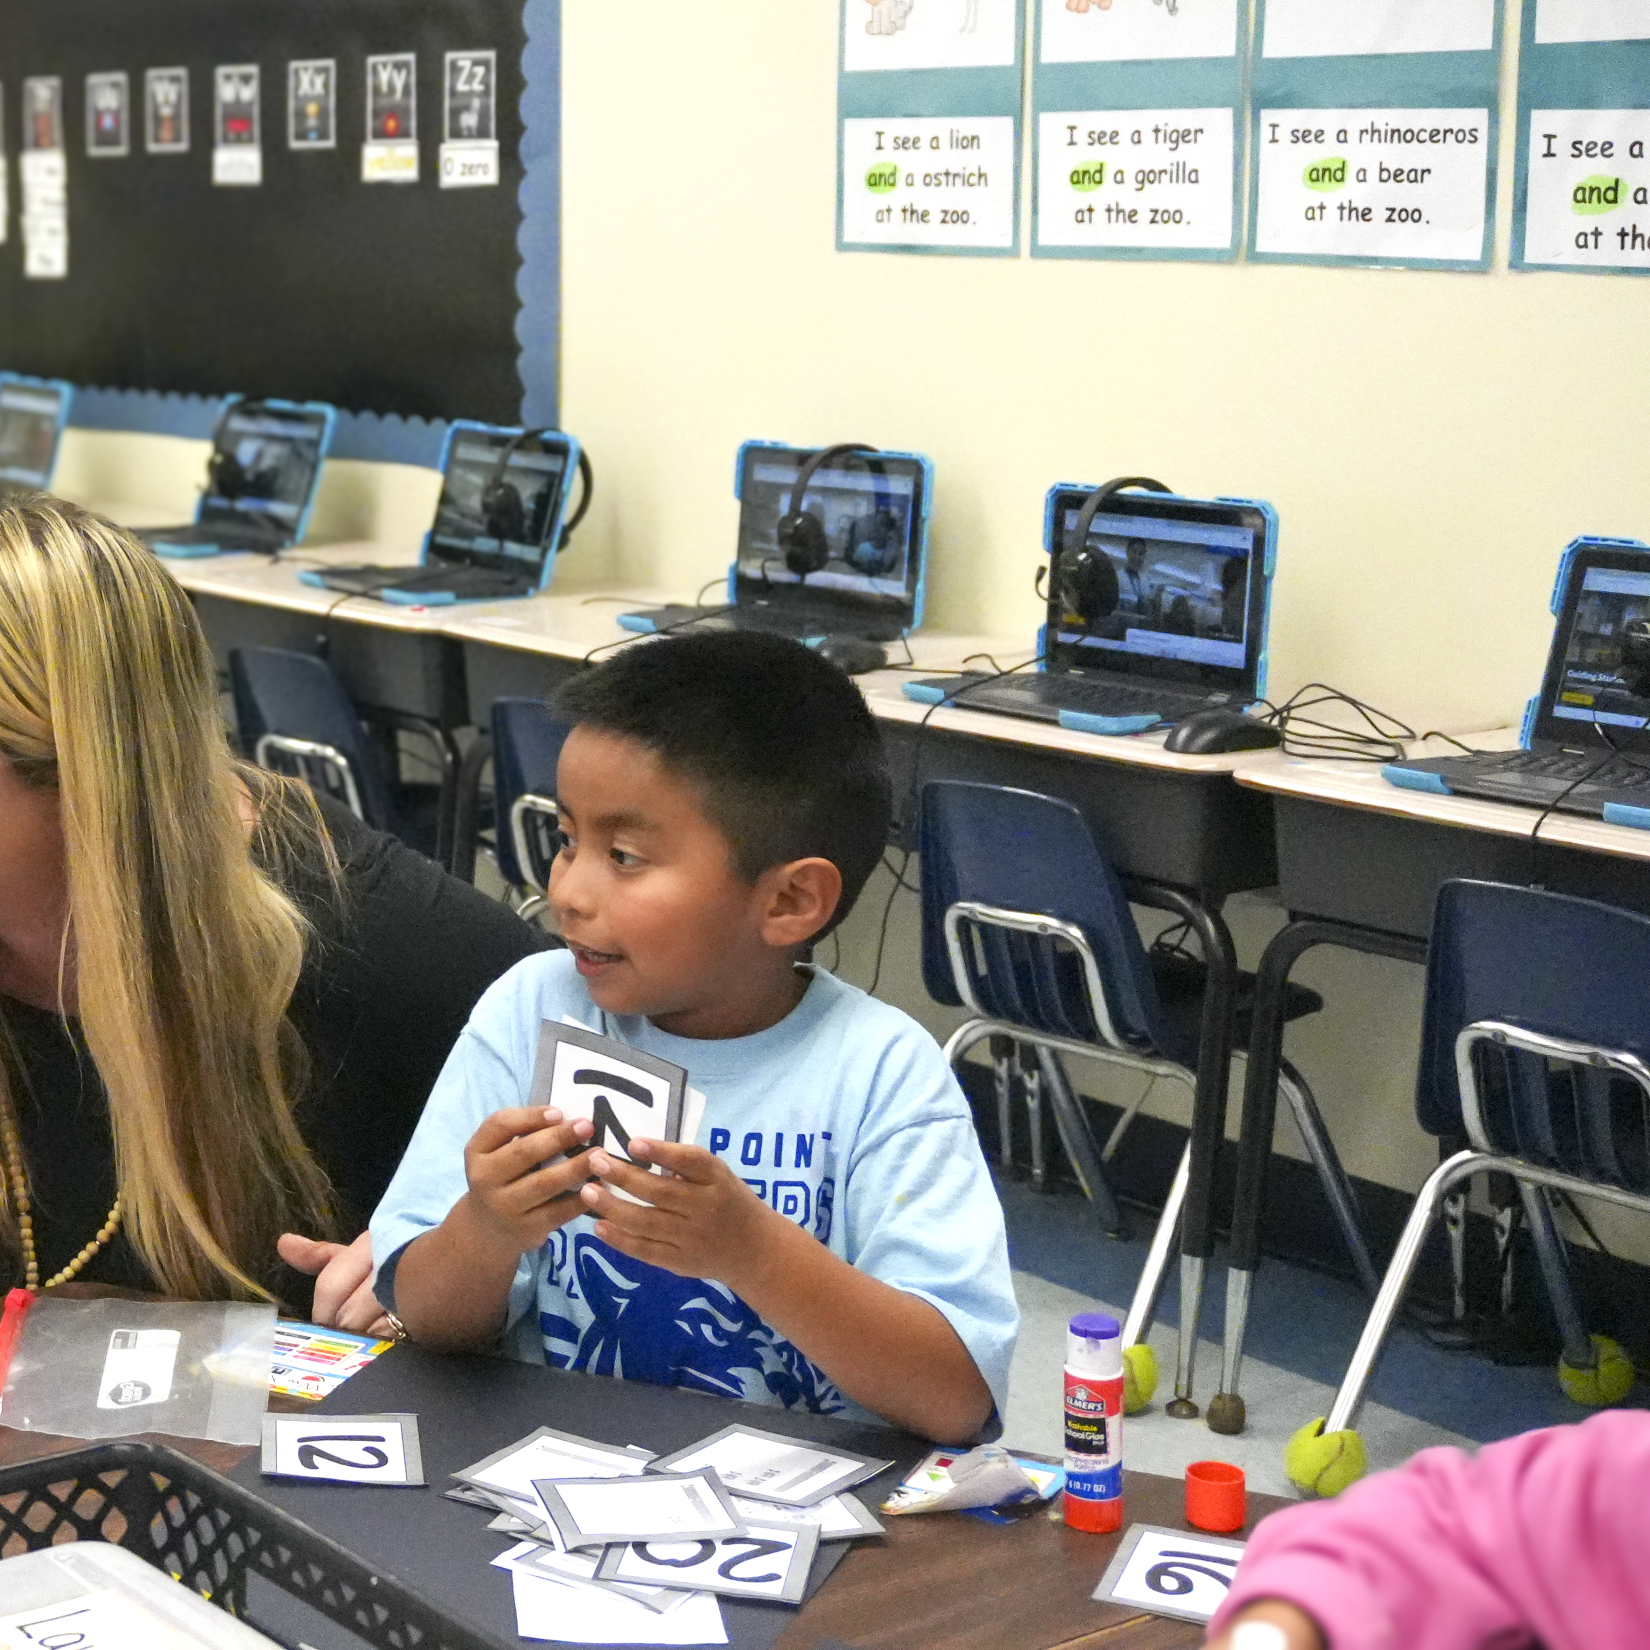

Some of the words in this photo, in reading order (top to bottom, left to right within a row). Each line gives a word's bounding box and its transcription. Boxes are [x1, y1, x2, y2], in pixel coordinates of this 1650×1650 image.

[298, 67, 326, 96] Xx
[377, 65, 407, 99] Yy
[455, 60, 486, 91] Zz
[875, 131, 885, 151] I
[893, 135, 921, 151] see
[929, 135, 941, 150] a
[949, 128, 981, 150] lion
[1066, 125, 1078, 147] I
[1087, 130, 1120, 147] see
[1130, 129, 1142, 145] a
[1151, 124, 1204, 152] tiger
[1268, 123, 1280, 144] I
[1290, 128, 1325, 144] see
[1336, 128, 1349, 144] a
[1359, 121, 1479, 144] rhinoceros
[1542, 133, 1557, 158] I
[1570, 140, 1614, 159] see
[1628, 140, 1644, 159] a
[460, 162, 490, 177] zero
[867, 166, 897, 188] and
[904, 172, 915, 188] a
[922, 165, 988, 188] ostrich
[1069, 162, 1104, 186] and
[1113, 169, 1125, 185] a
[1134, 160, 1200, 192] gorilla
[1308, 160, 1346, 183] and
[1355, 167, 1368, 183] a
[1378, 161, 1432, 184] bear
[1572, 177, 1620, 205] and
[1632, 186, 1649, 205] a
[875, 205, 893, 223] at
[901, 203, 930, 224] the
[939, 208, 978, 226] zoo.
[1074, 204, 1095, 224] at
[1104, 202, 1139, 224] the
[1149, 208, 1193, 226] zoo.
[1304, 201, 1327, 221] at
[1337, 199, 1373, 223] the
[1384, 207, 1430, 224] zoo.
[1574, 226, 1604, 250] at
[1616, 223, 1650, 251] th
[710, 1127, 832, 1168] POIN
[1066, 1396, 1103, 1412] ELMER'S
[295, 1432, 390, 1473] 12
